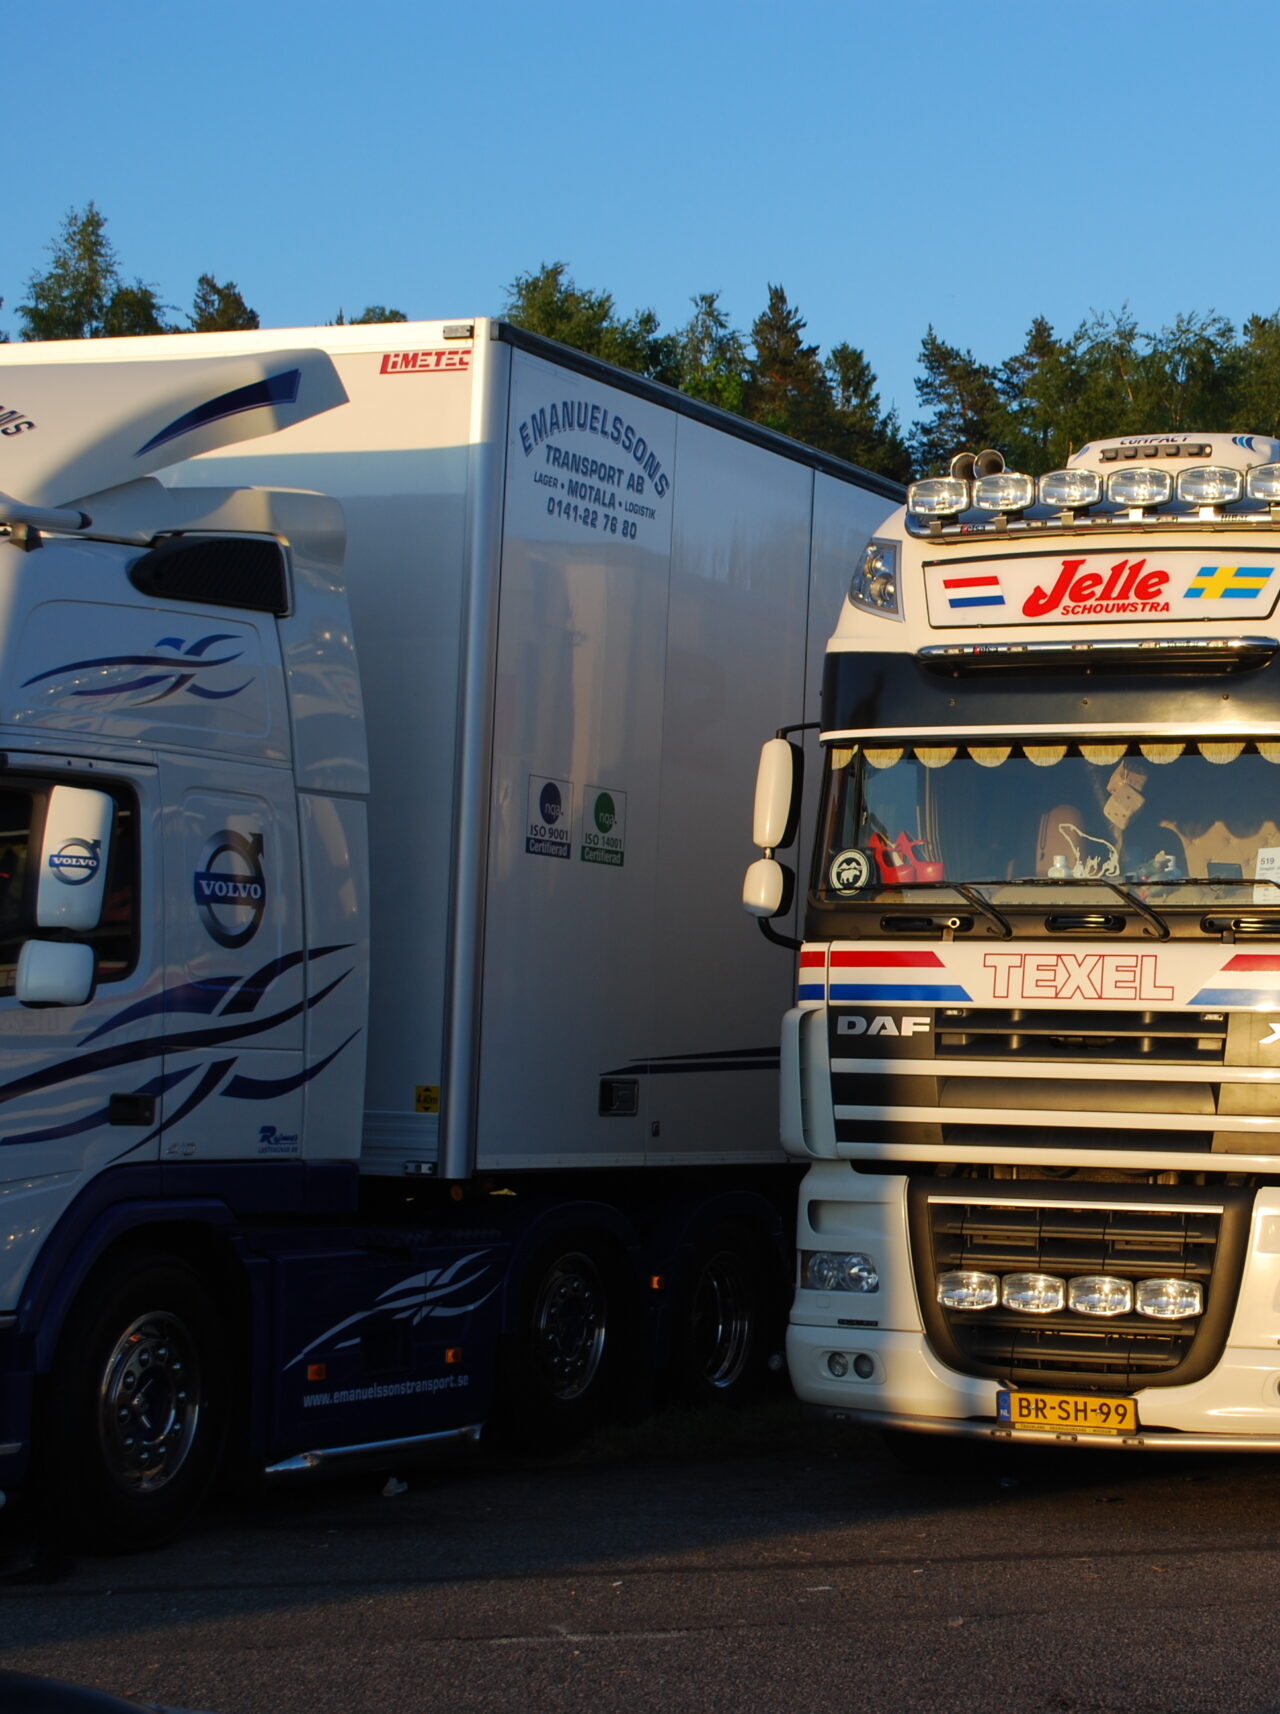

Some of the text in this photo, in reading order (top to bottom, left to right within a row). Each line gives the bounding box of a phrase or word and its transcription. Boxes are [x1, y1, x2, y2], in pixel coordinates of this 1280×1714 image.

[519, 401, 671, 498] EMANUELSSONS
[545, 444, 646, 496] TRANSPORT AB
[533, 471, 656, 520] LAGER MOTALA LOGISTIK
[547, 496, 637, 541] 0141-22 76 80
[1022, 558, 1170, 617] Jelle
[1061, 601, 1170, 615] SCHOUWSTRA
[530, 825, 568, 841] ISO 9001
[585, 833, 623, 849] ISO 14001
[529, 839, 568, 857] Certifierad
[585, 847, 621, 865] Certifierad
[52, 856, 97, 868] VOLVO
[1260, 857, 1275, 866] 519
[199, 879, 262, 899] VOLVO
[983, 953, 1175, 1000] TEXEL
[837, 1015, 931, 1036] DAF
[303, 1375, 470, 1408] www.emanuelssonstransport.se
[1000, 1409, 1010, 1417] NL
[1018, 1397, 1128, 1424] BR-SH-99
